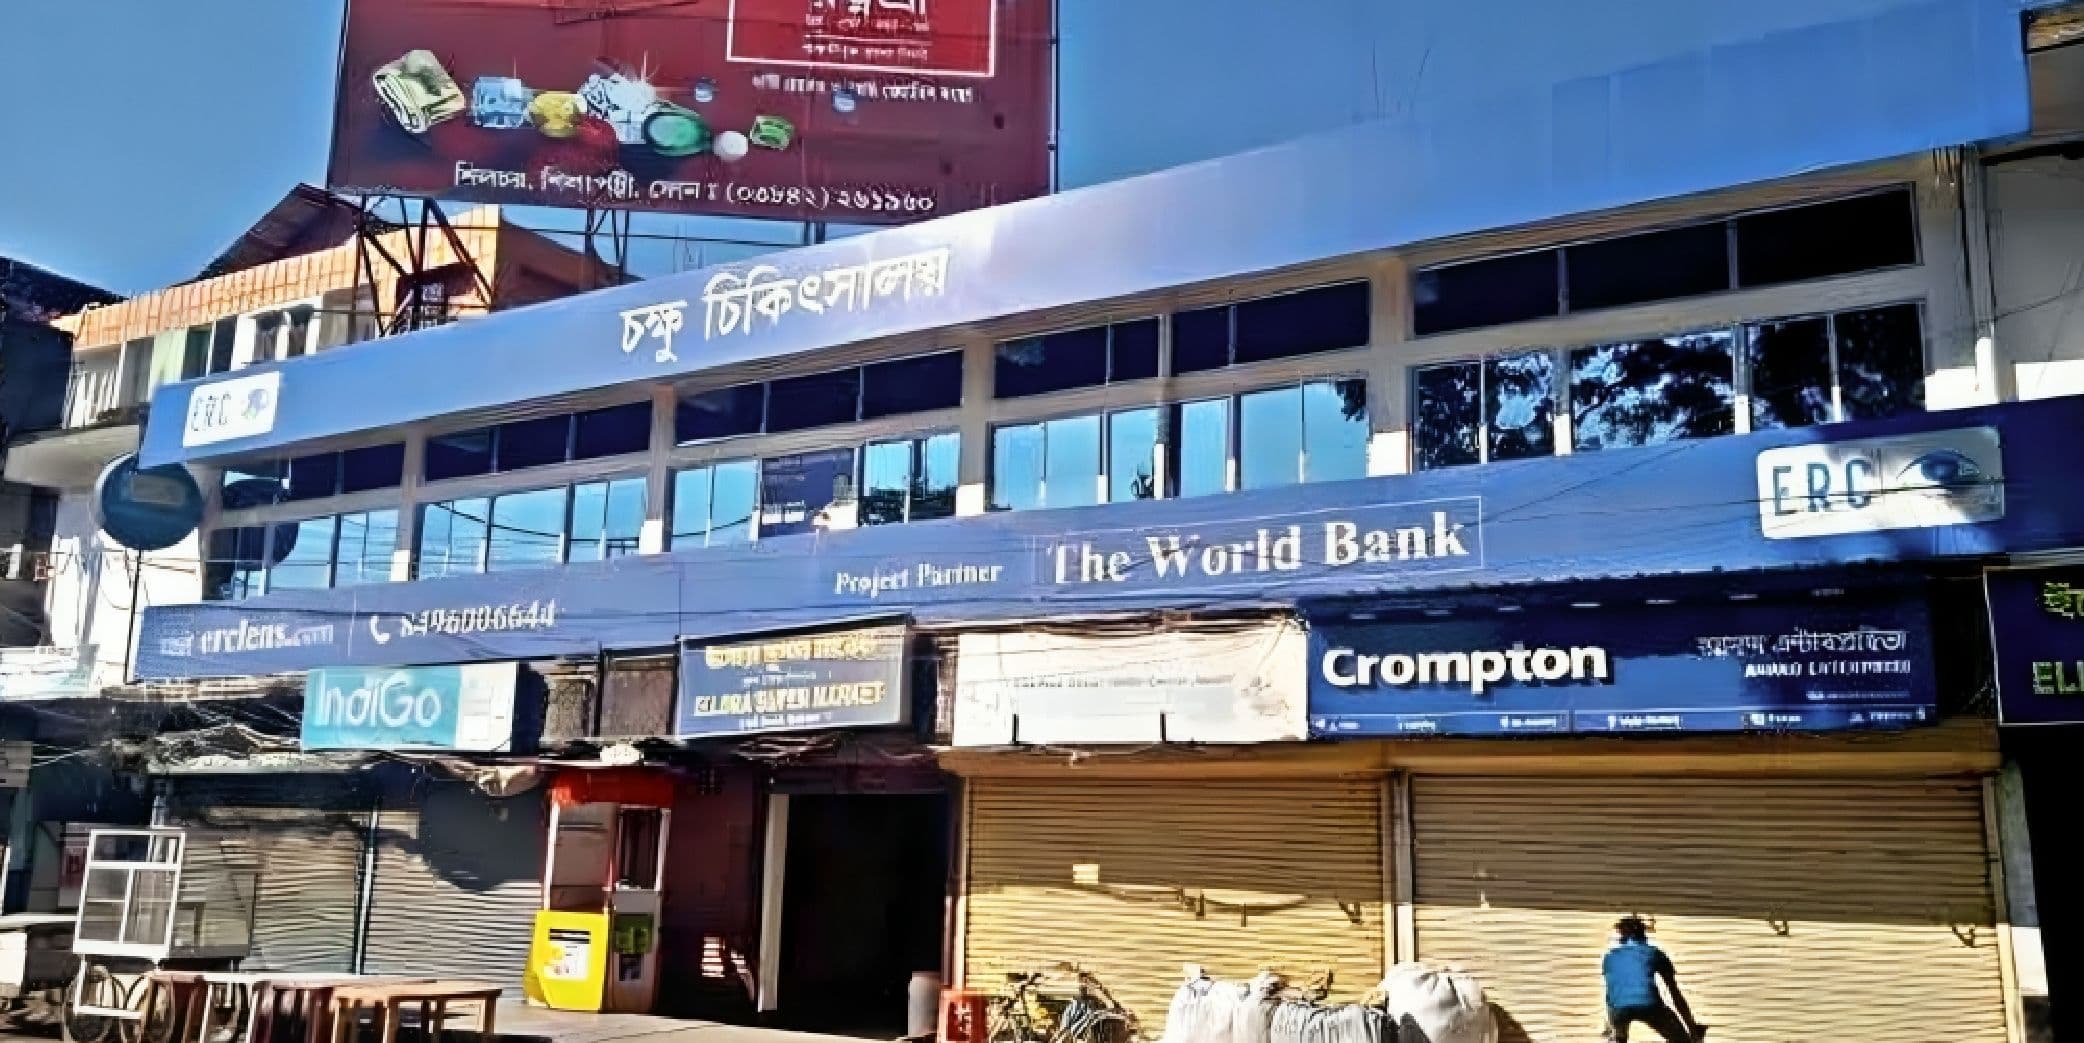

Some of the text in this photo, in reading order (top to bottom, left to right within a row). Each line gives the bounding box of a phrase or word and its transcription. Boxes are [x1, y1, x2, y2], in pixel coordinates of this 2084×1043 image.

[1772, 458, 1873, 516] ERC
[1048, 511, 1470, 584] The World Bank
[1321, 641, 1609, 695] Crompton
[313, 670, 443, 728] IndiGo
